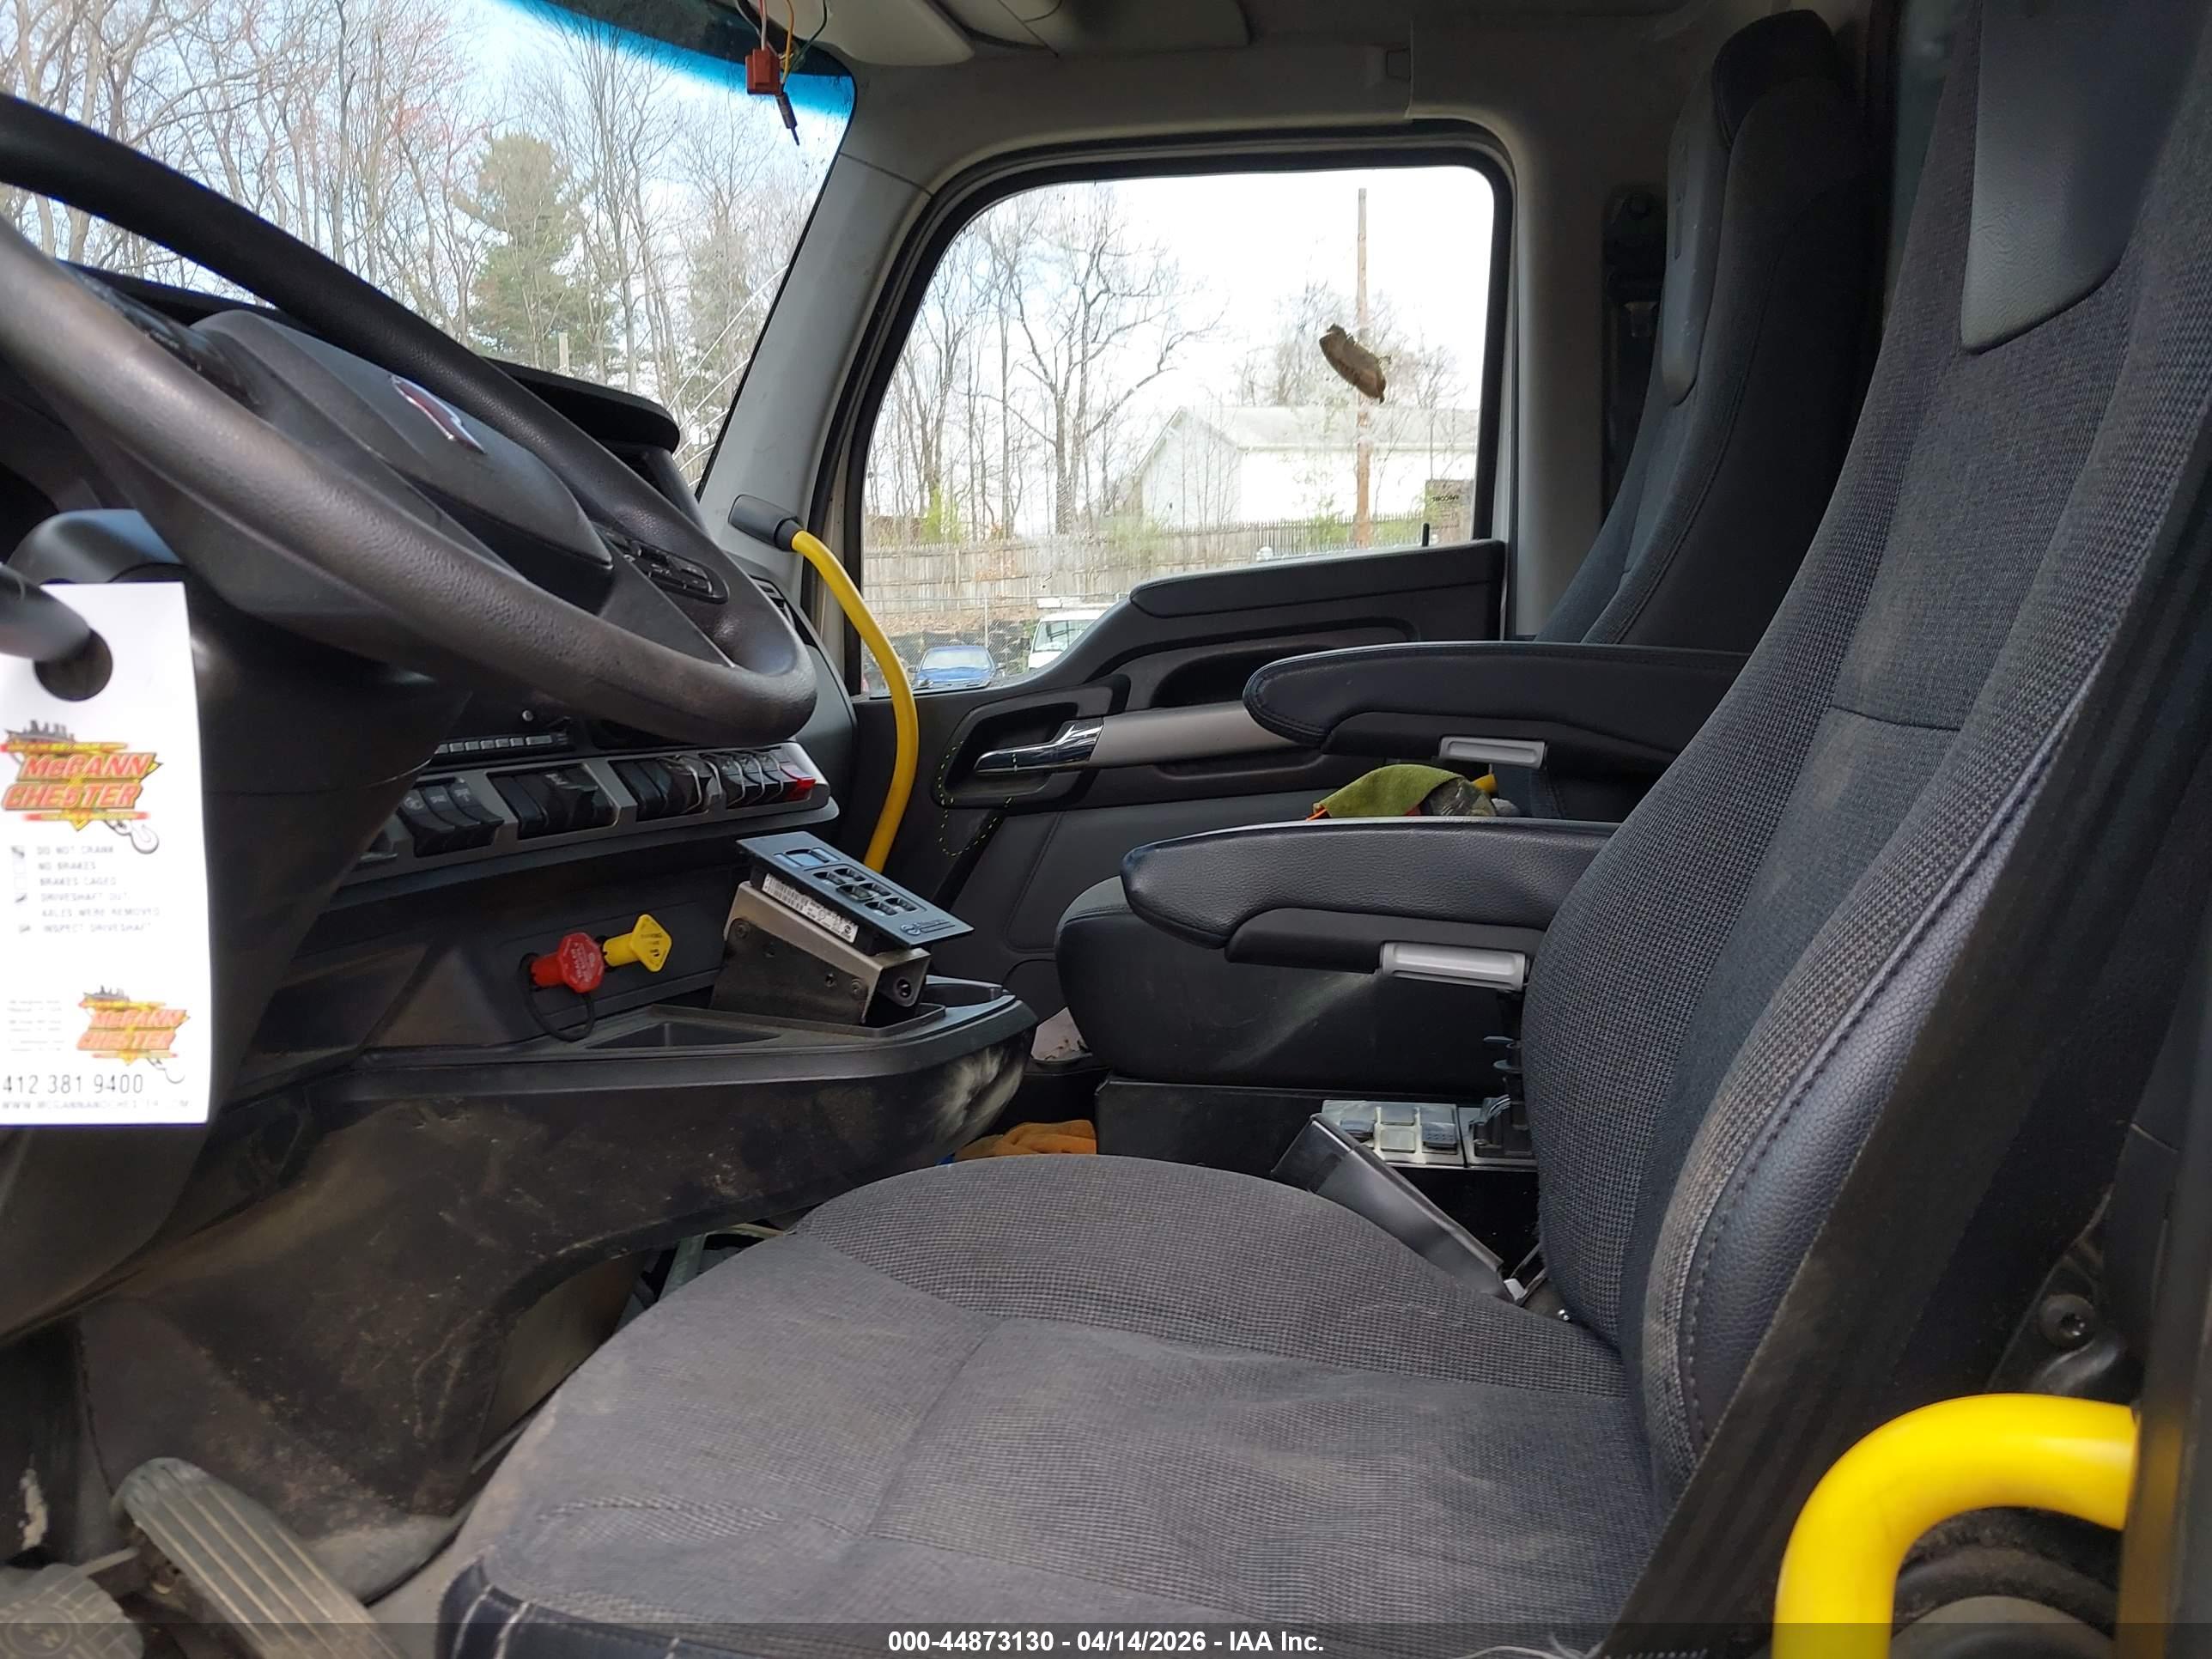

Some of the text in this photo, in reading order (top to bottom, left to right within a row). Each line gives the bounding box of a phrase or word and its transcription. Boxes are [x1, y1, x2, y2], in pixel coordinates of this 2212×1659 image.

[3, 784, 143, 809] CHESTER
[77, 1030, 175, 1049] CHESTER
[3, 1074, 143, 1094] 412 381 9400
